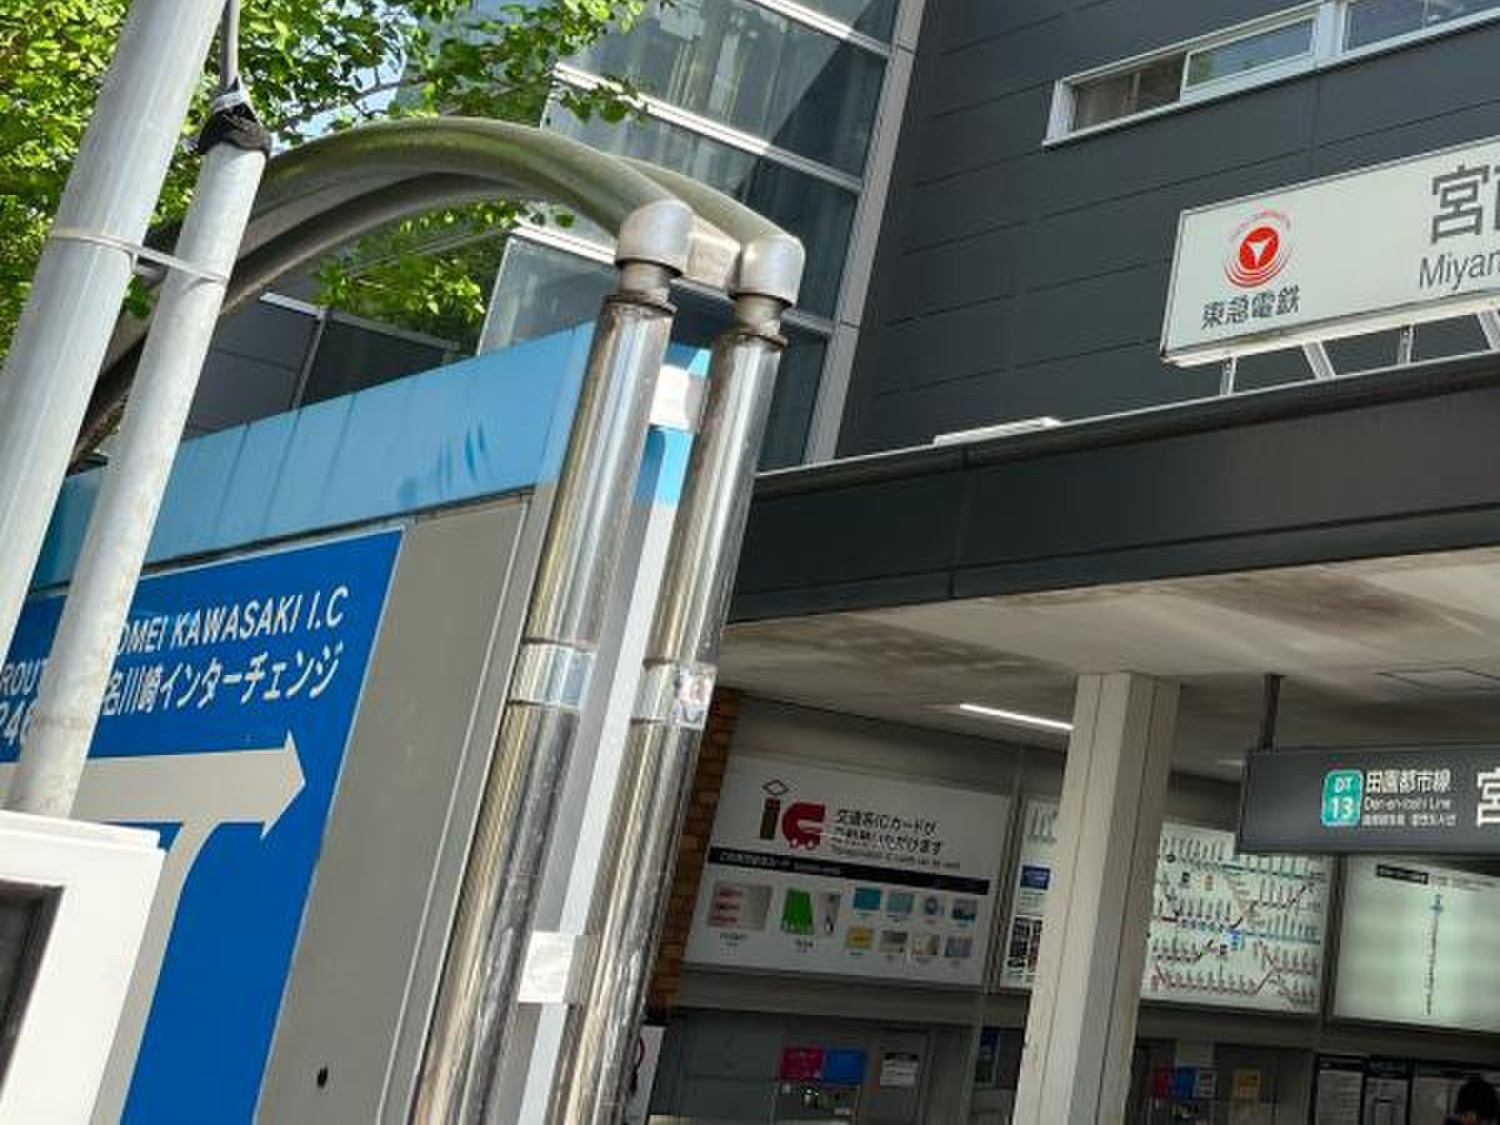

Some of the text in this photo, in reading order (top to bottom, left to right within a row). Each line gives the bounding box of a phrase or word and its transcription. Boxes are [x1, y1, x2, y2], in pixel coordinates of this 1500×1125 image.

[1201, 284, 1300, 330] 東急電鉄
[170, 594, 302, 650] KAWASAKI
[101, 641, 345, 716] 名川崎インターチェンジ
[1331, 797, 1354, 819] 13
